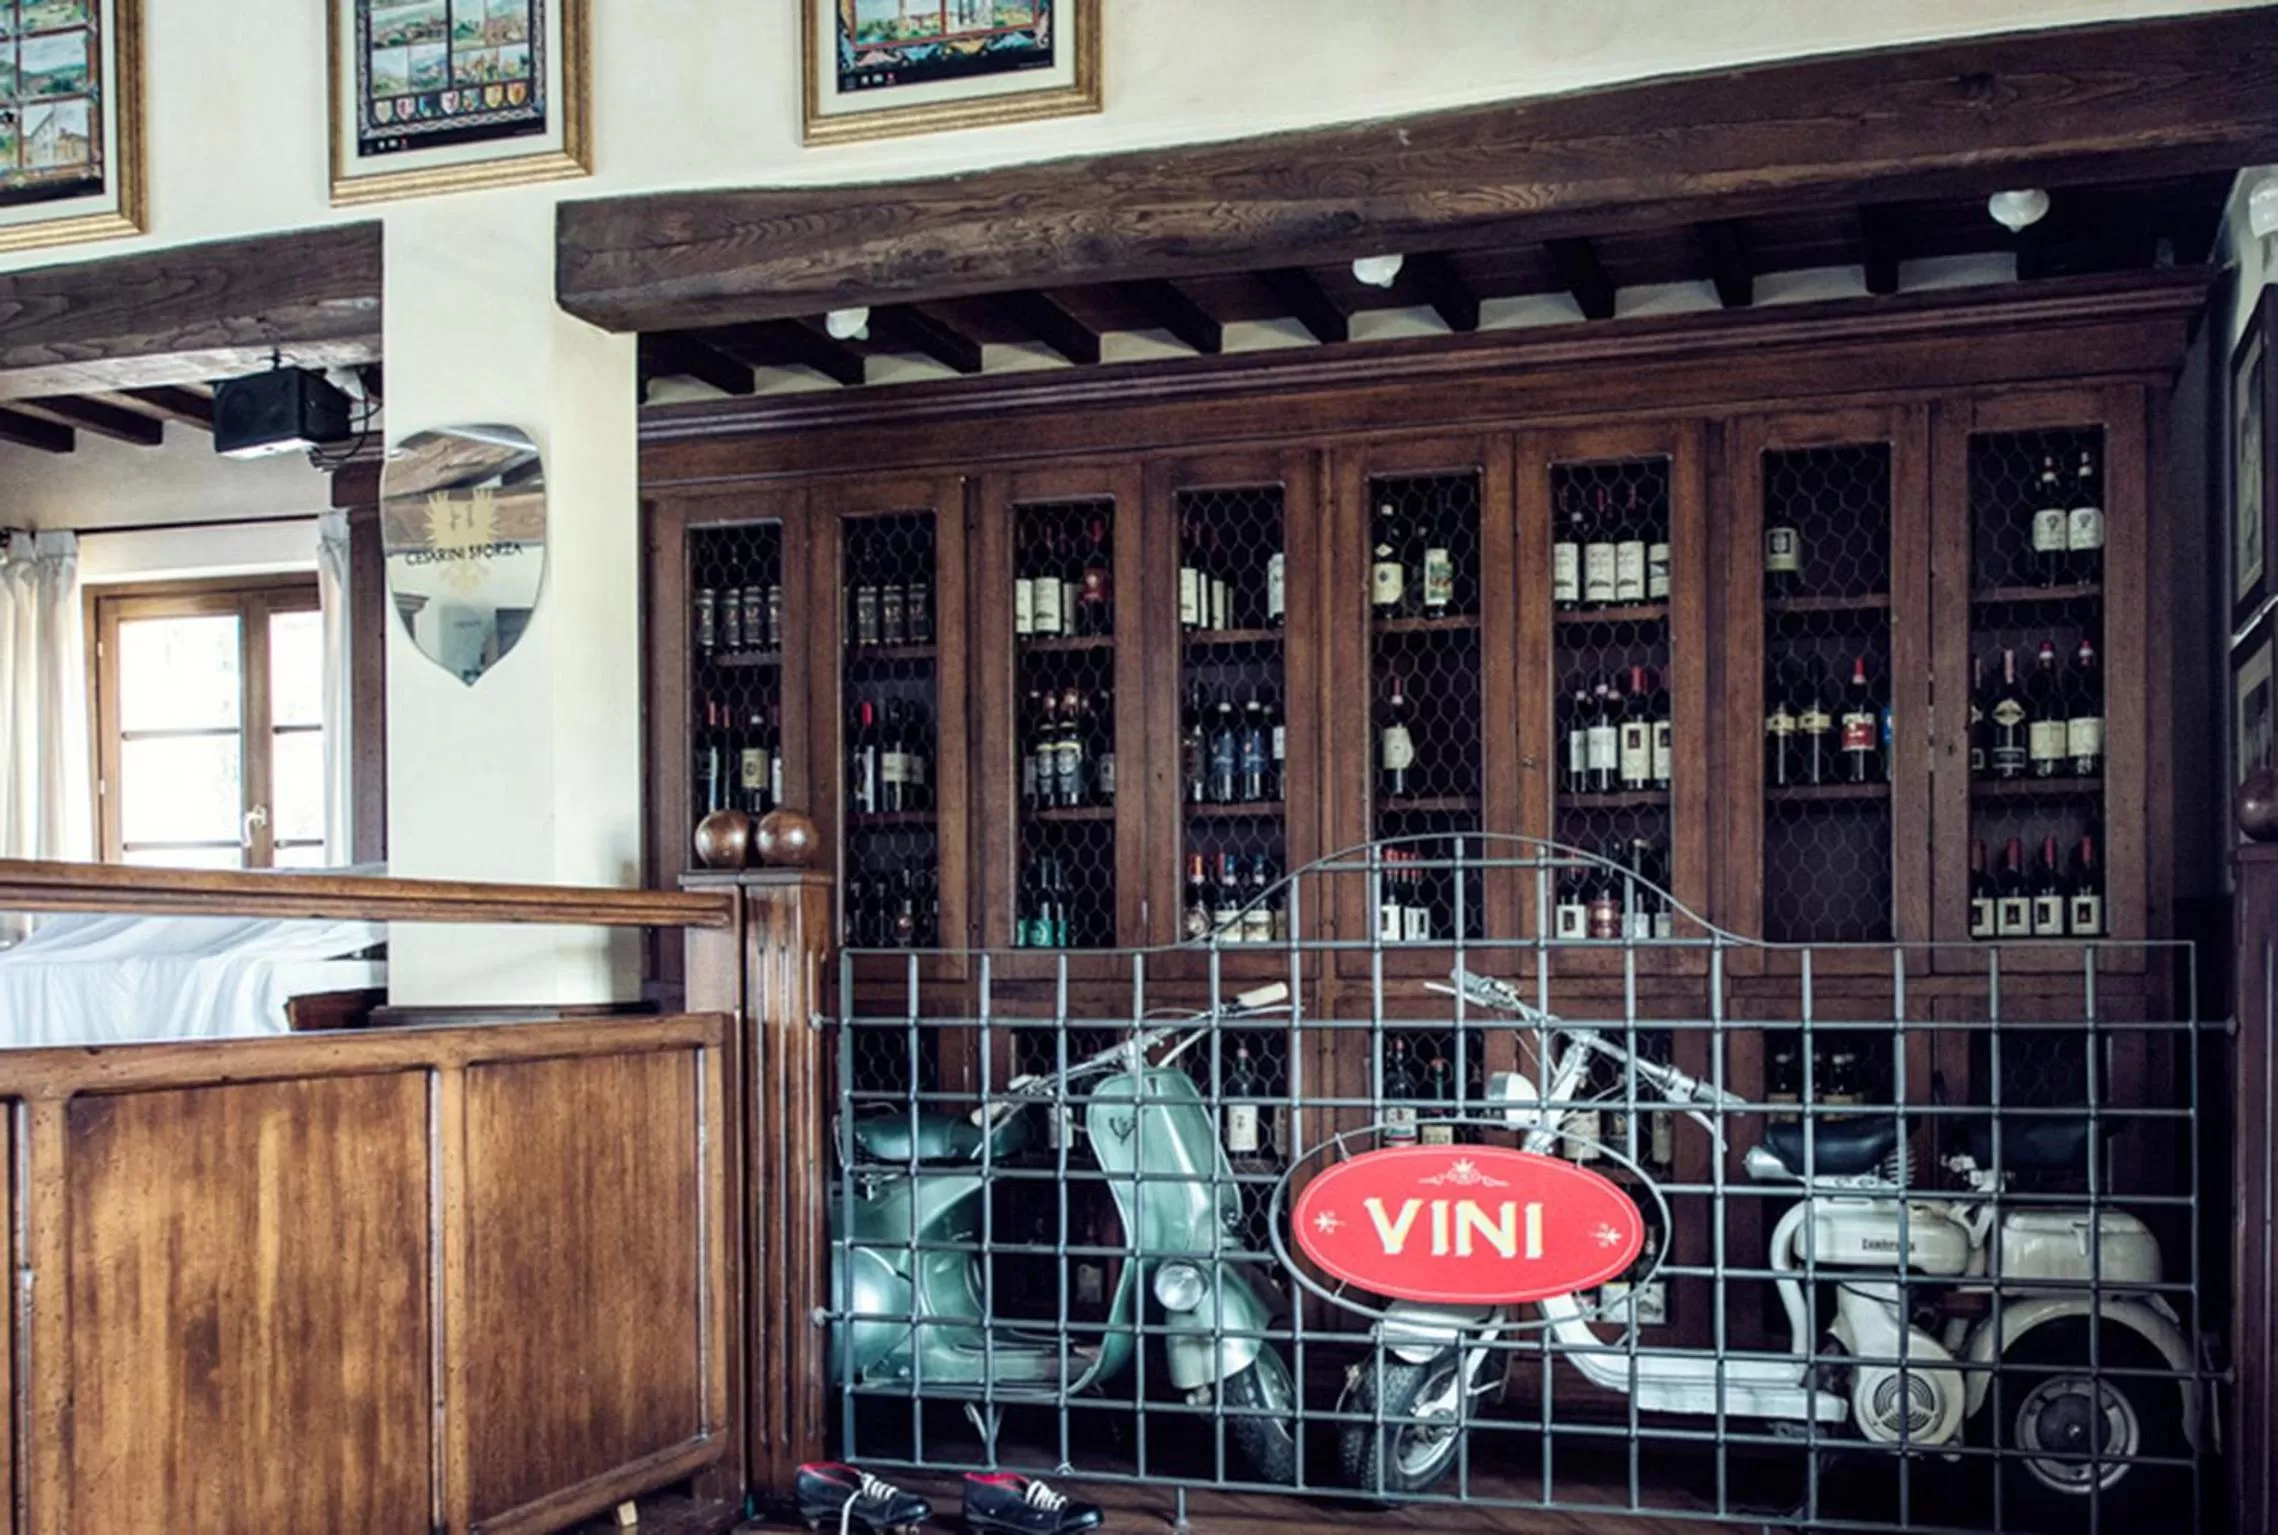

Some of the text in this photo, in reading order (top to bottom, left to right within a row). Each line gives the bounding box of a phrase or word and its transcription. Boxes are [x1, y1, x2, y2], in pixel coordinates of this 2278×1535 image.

[405, 541, 523, 566] CESARINI SFORZA
[1363, 1197, 1544, 1260] VINI
[1862, 1238, 1916, 1253] Lambrea
